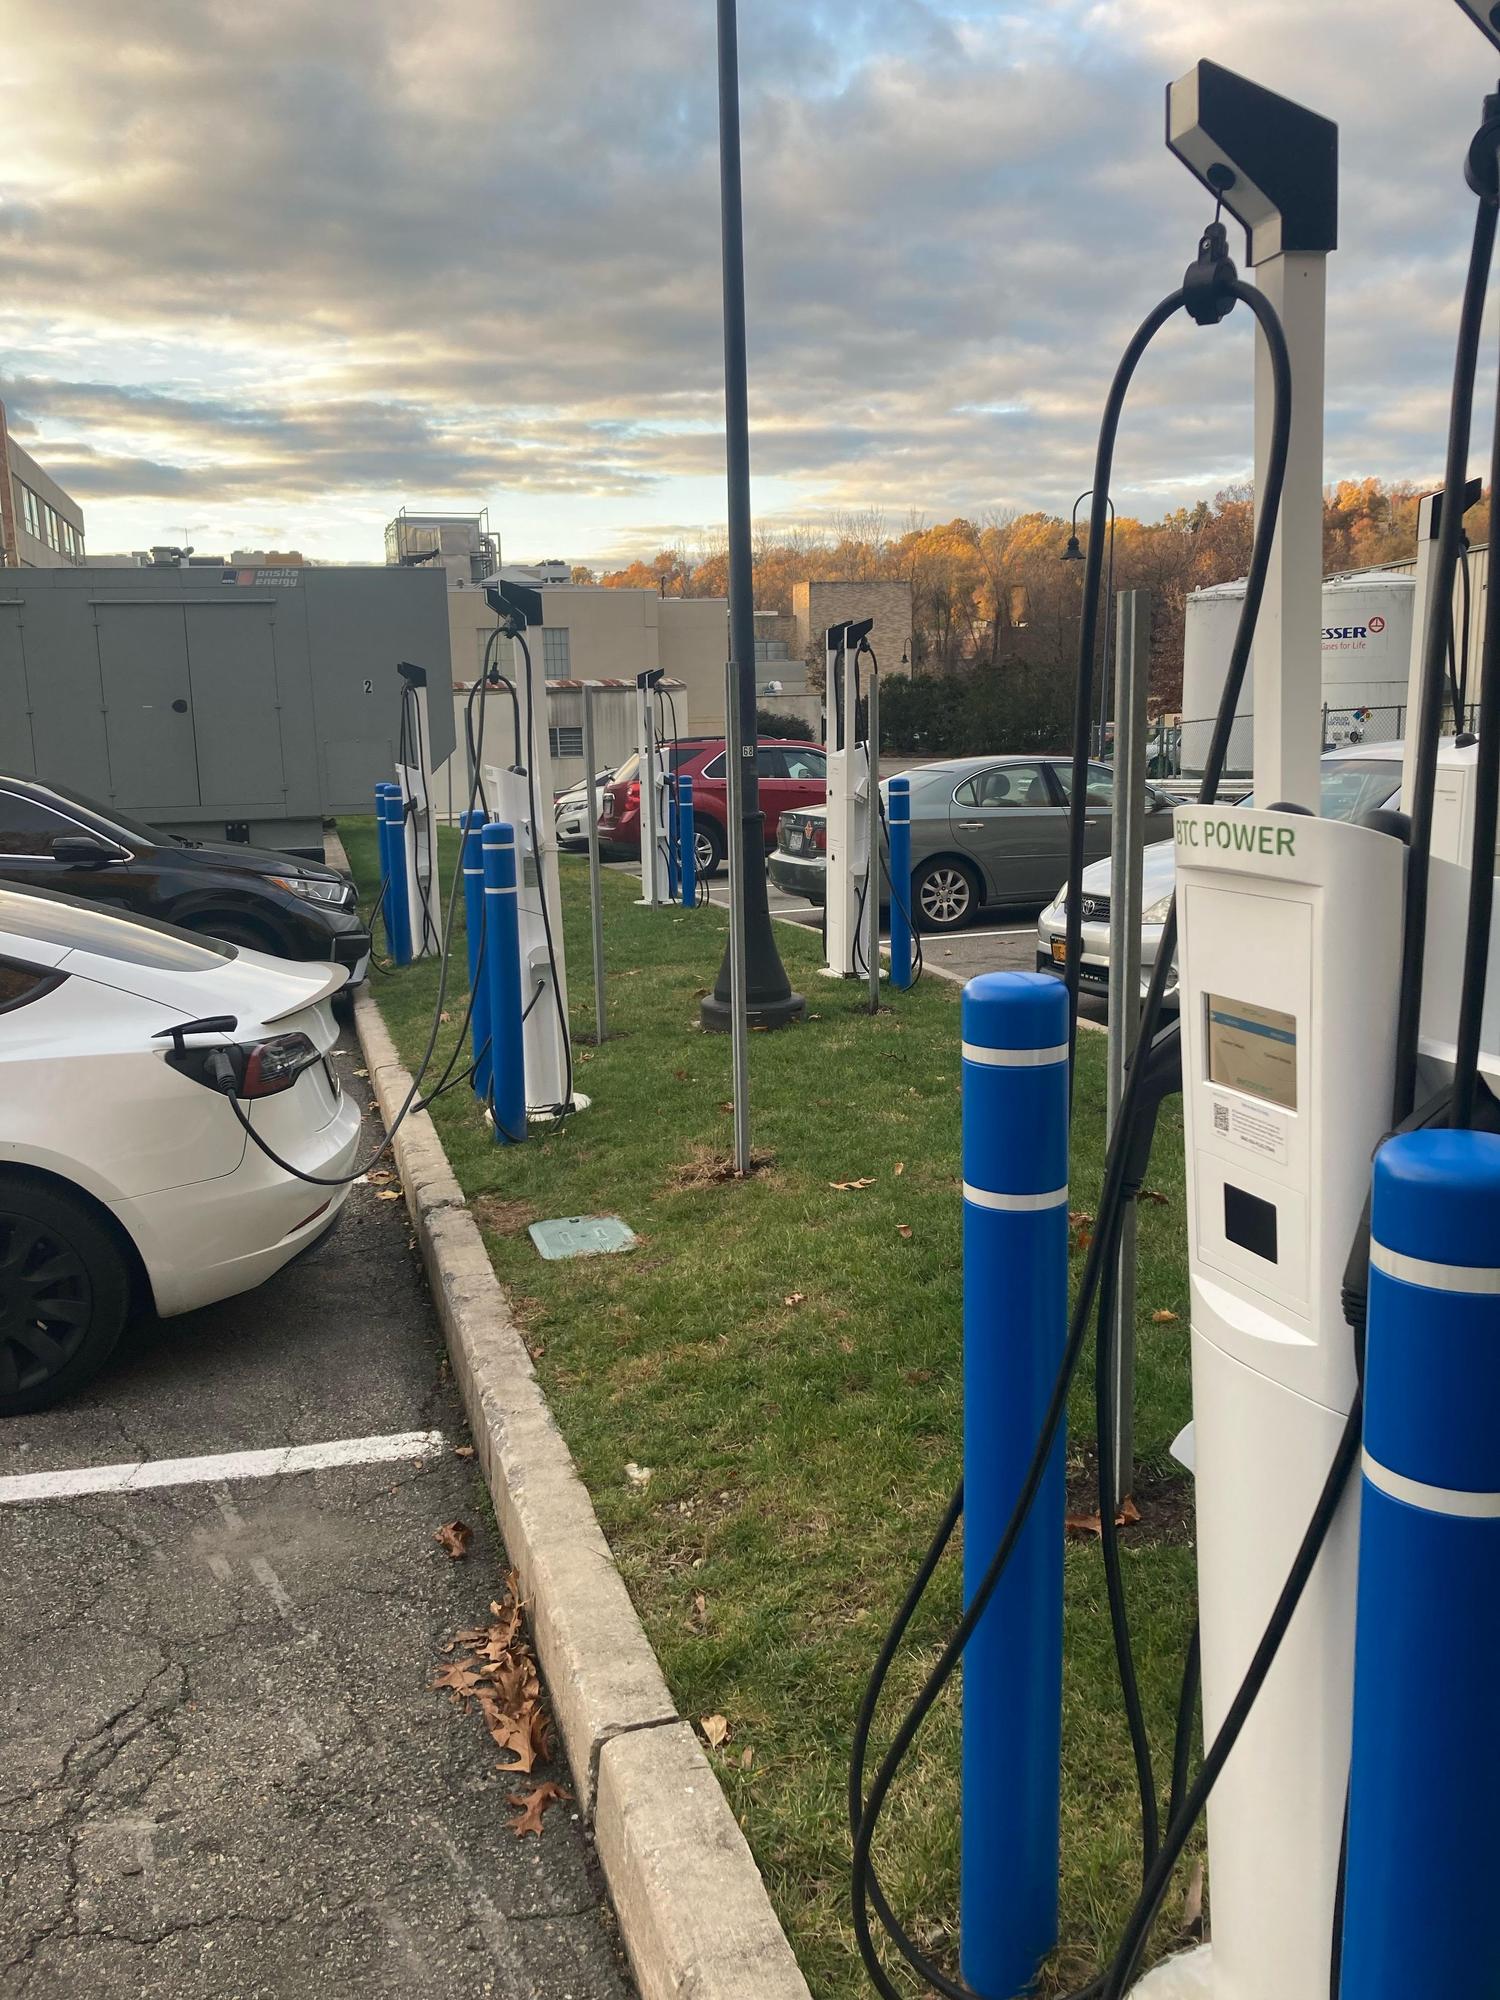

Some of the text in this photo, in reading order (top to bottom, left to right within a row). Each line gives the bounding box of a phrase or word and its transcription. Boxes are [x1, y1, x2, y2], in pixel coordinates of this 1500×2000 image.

[257, 568, 299, 577] onsite
[255, 577, 298, 587] energy
[1340, 642, 1351, 650] for
[1352, 641, 1367, 650] Life
[364, 680, 373, 694] 2
[743, 746, 753, 756] 68
[1176, 820, 1295, 857] BTC POWER
